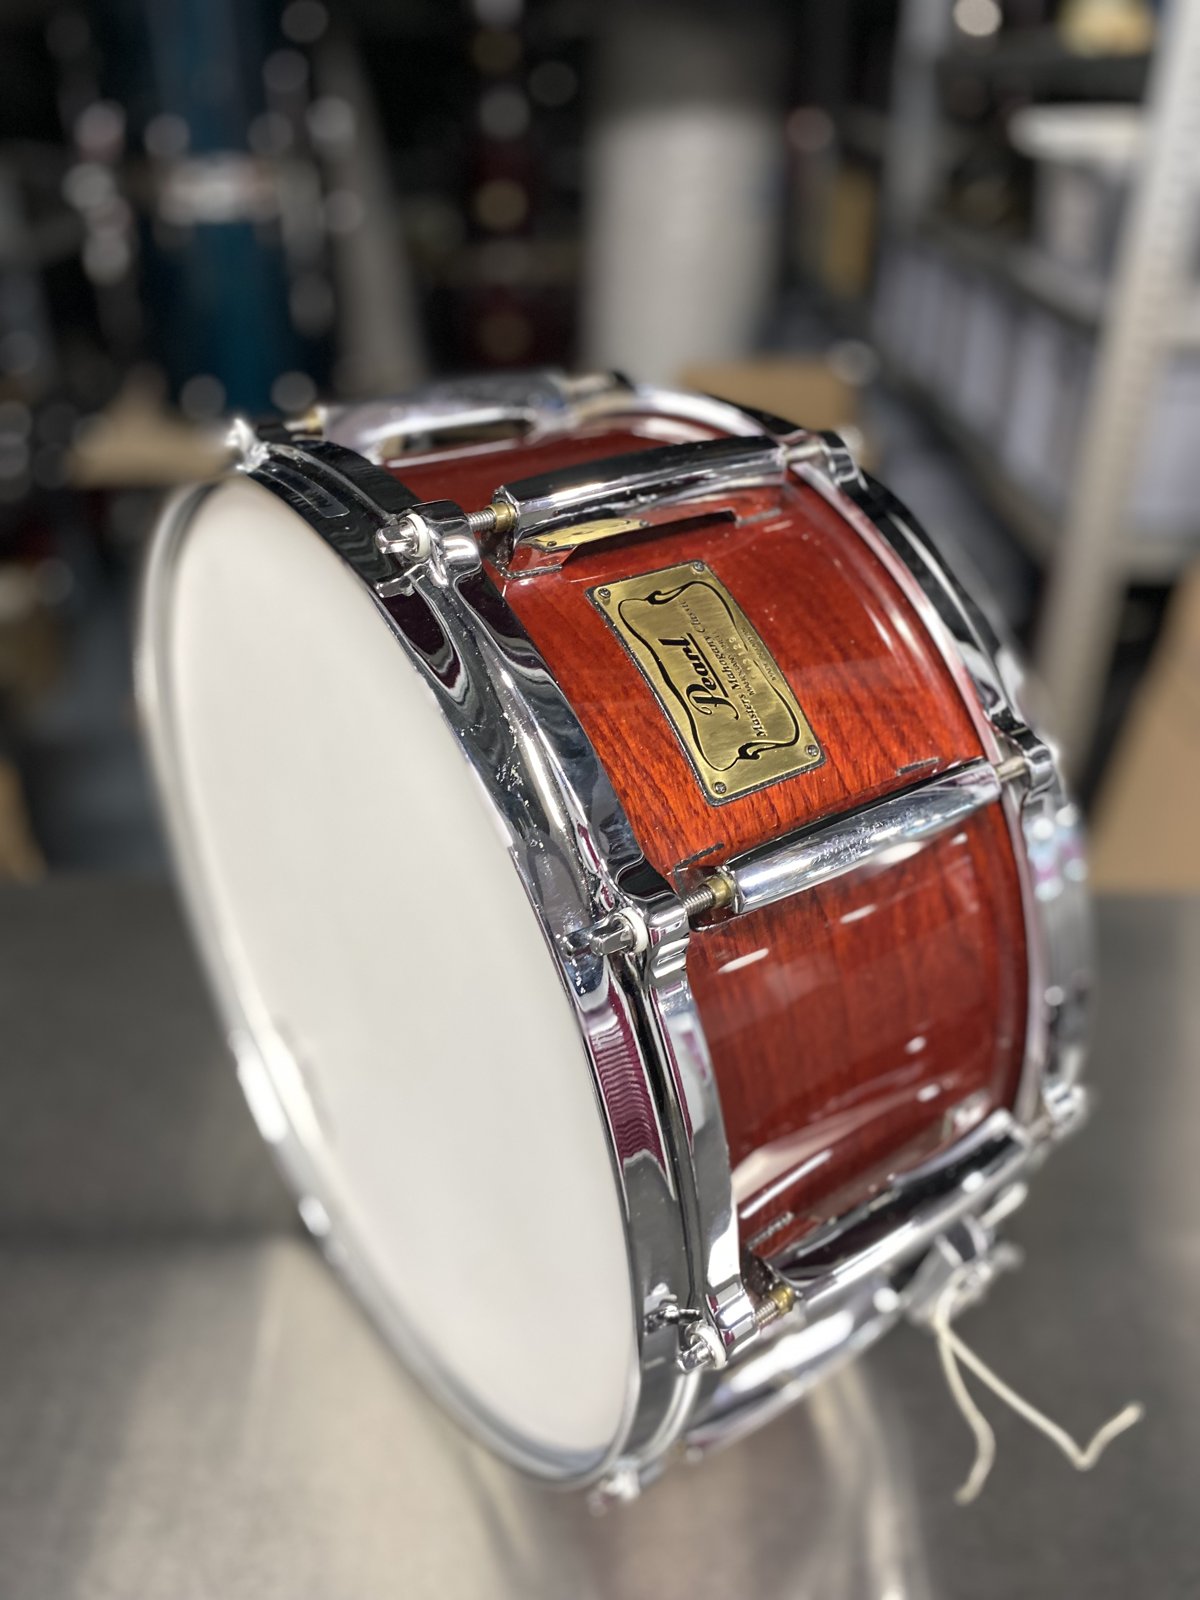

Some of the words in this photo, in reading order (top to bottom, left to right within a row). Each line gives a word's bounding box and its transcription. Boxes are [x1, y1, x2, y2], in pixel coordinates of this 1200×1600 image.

[658, 634, 740, 720] Pearl
[704, 635, 742, 690] Mahogany
[739, 692, 768, 737] Masters
